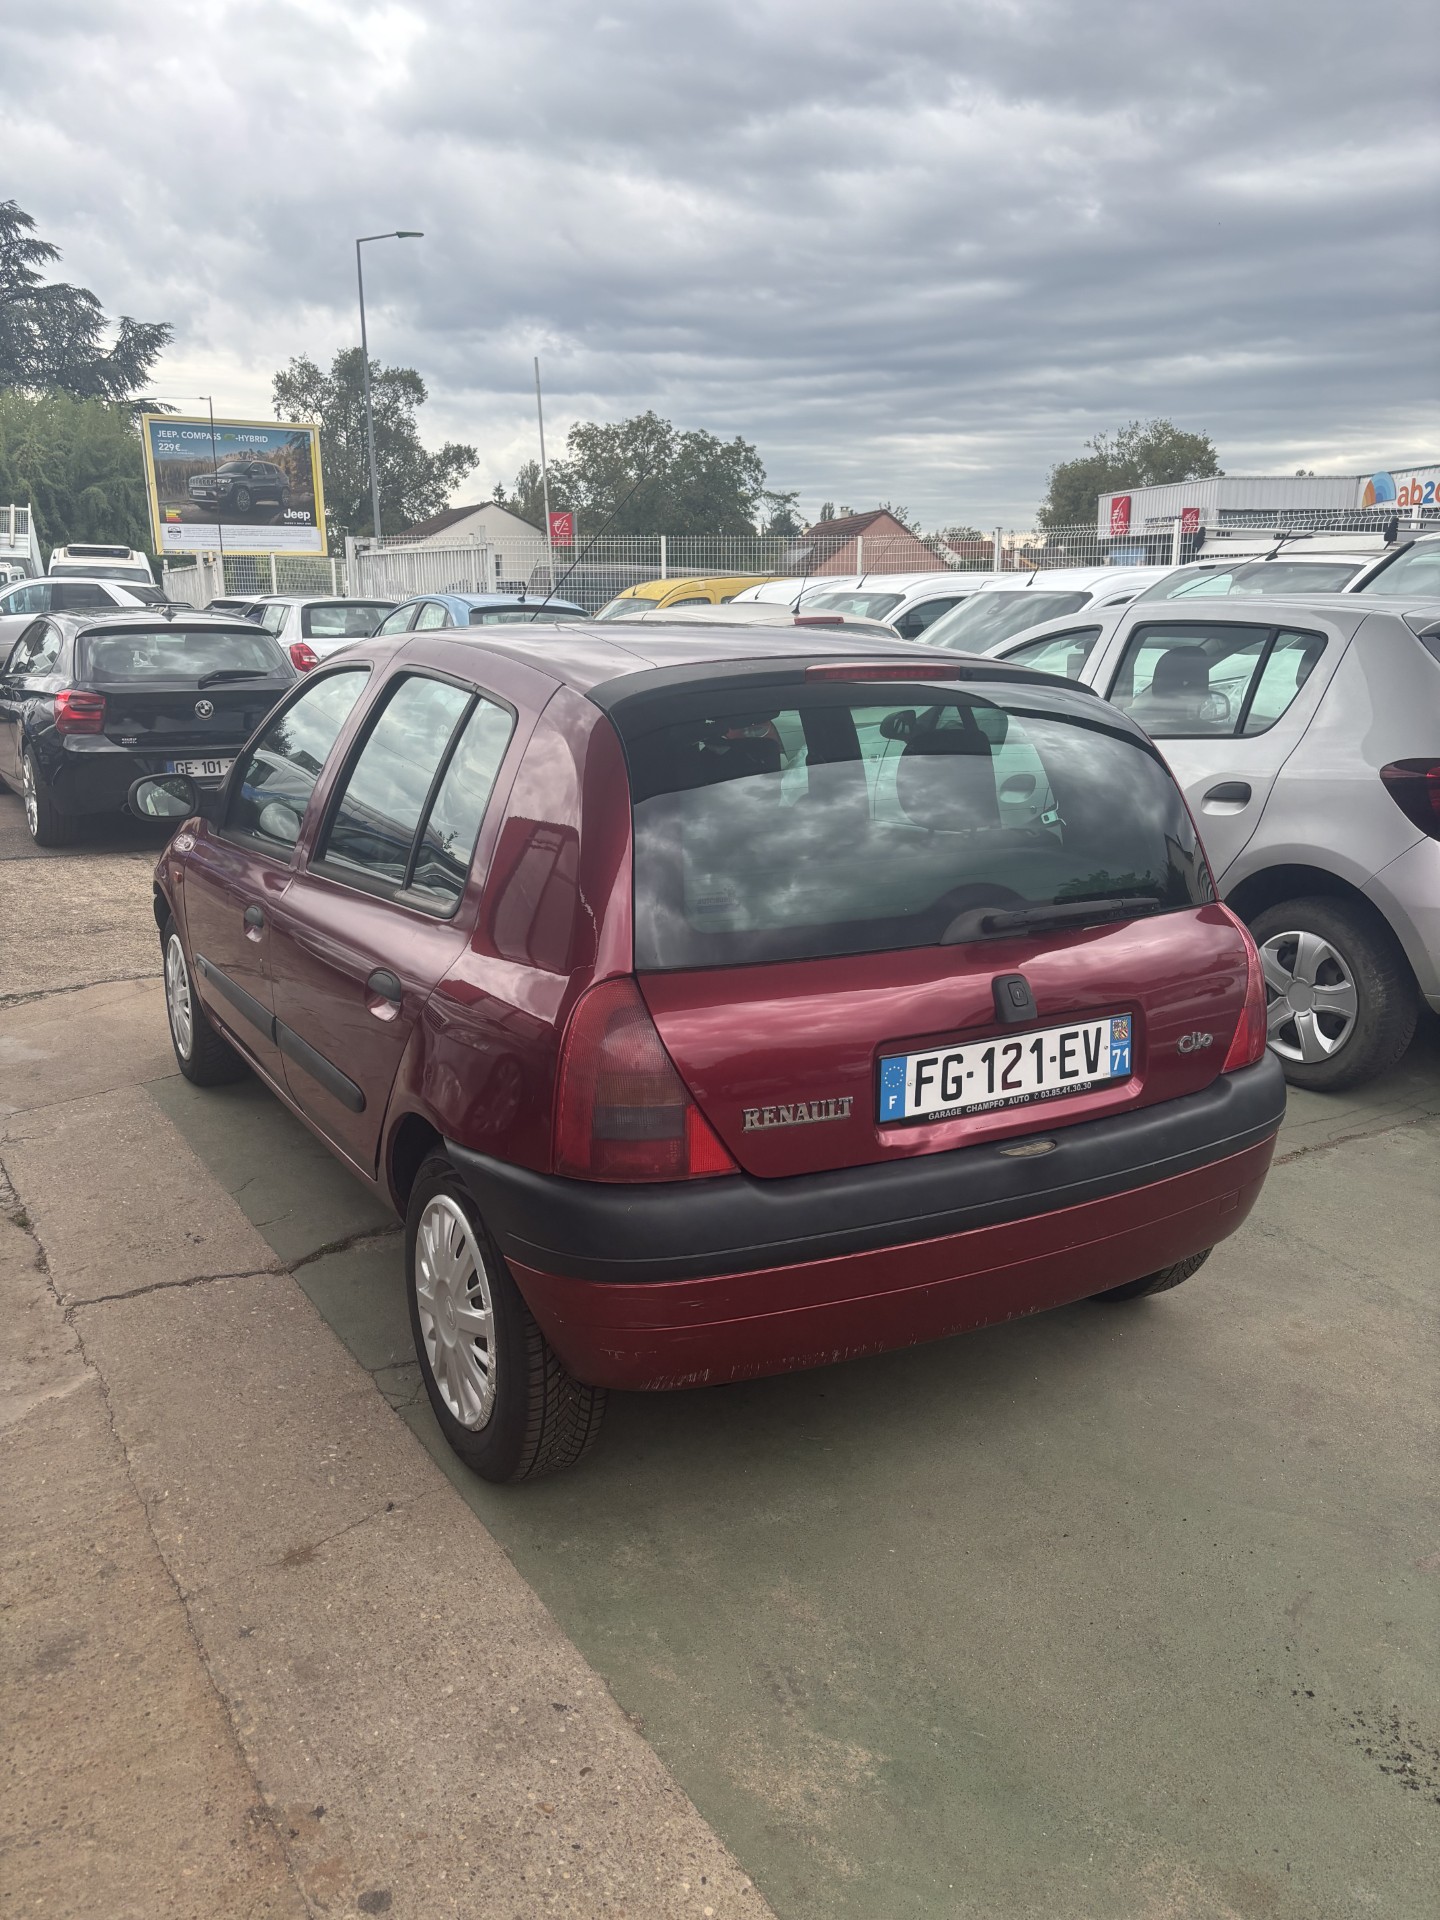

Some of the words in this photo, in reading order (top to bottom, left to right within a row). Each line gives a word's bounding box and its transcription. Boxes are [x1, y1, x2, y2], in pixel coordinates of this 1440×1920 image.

[181, 431, 222, 441] COMPASS
[283, 508, 311, 521] Jeep
[175, 760, 236, 775] GE-101-
[1112, 1047, 1129, 1071] 71
[888, 1095, 898, 1110] F
[928, 1107, 962, 1121] GARAGE
[966, 1099, 1005, 1114] CHAMPFO
[1008, 1094, 1031, 1106] AUTO
[1040, 1082, 1092, 1098] 03.85.41.30.30
[742, 1096, 854, 1131] RENAULT
